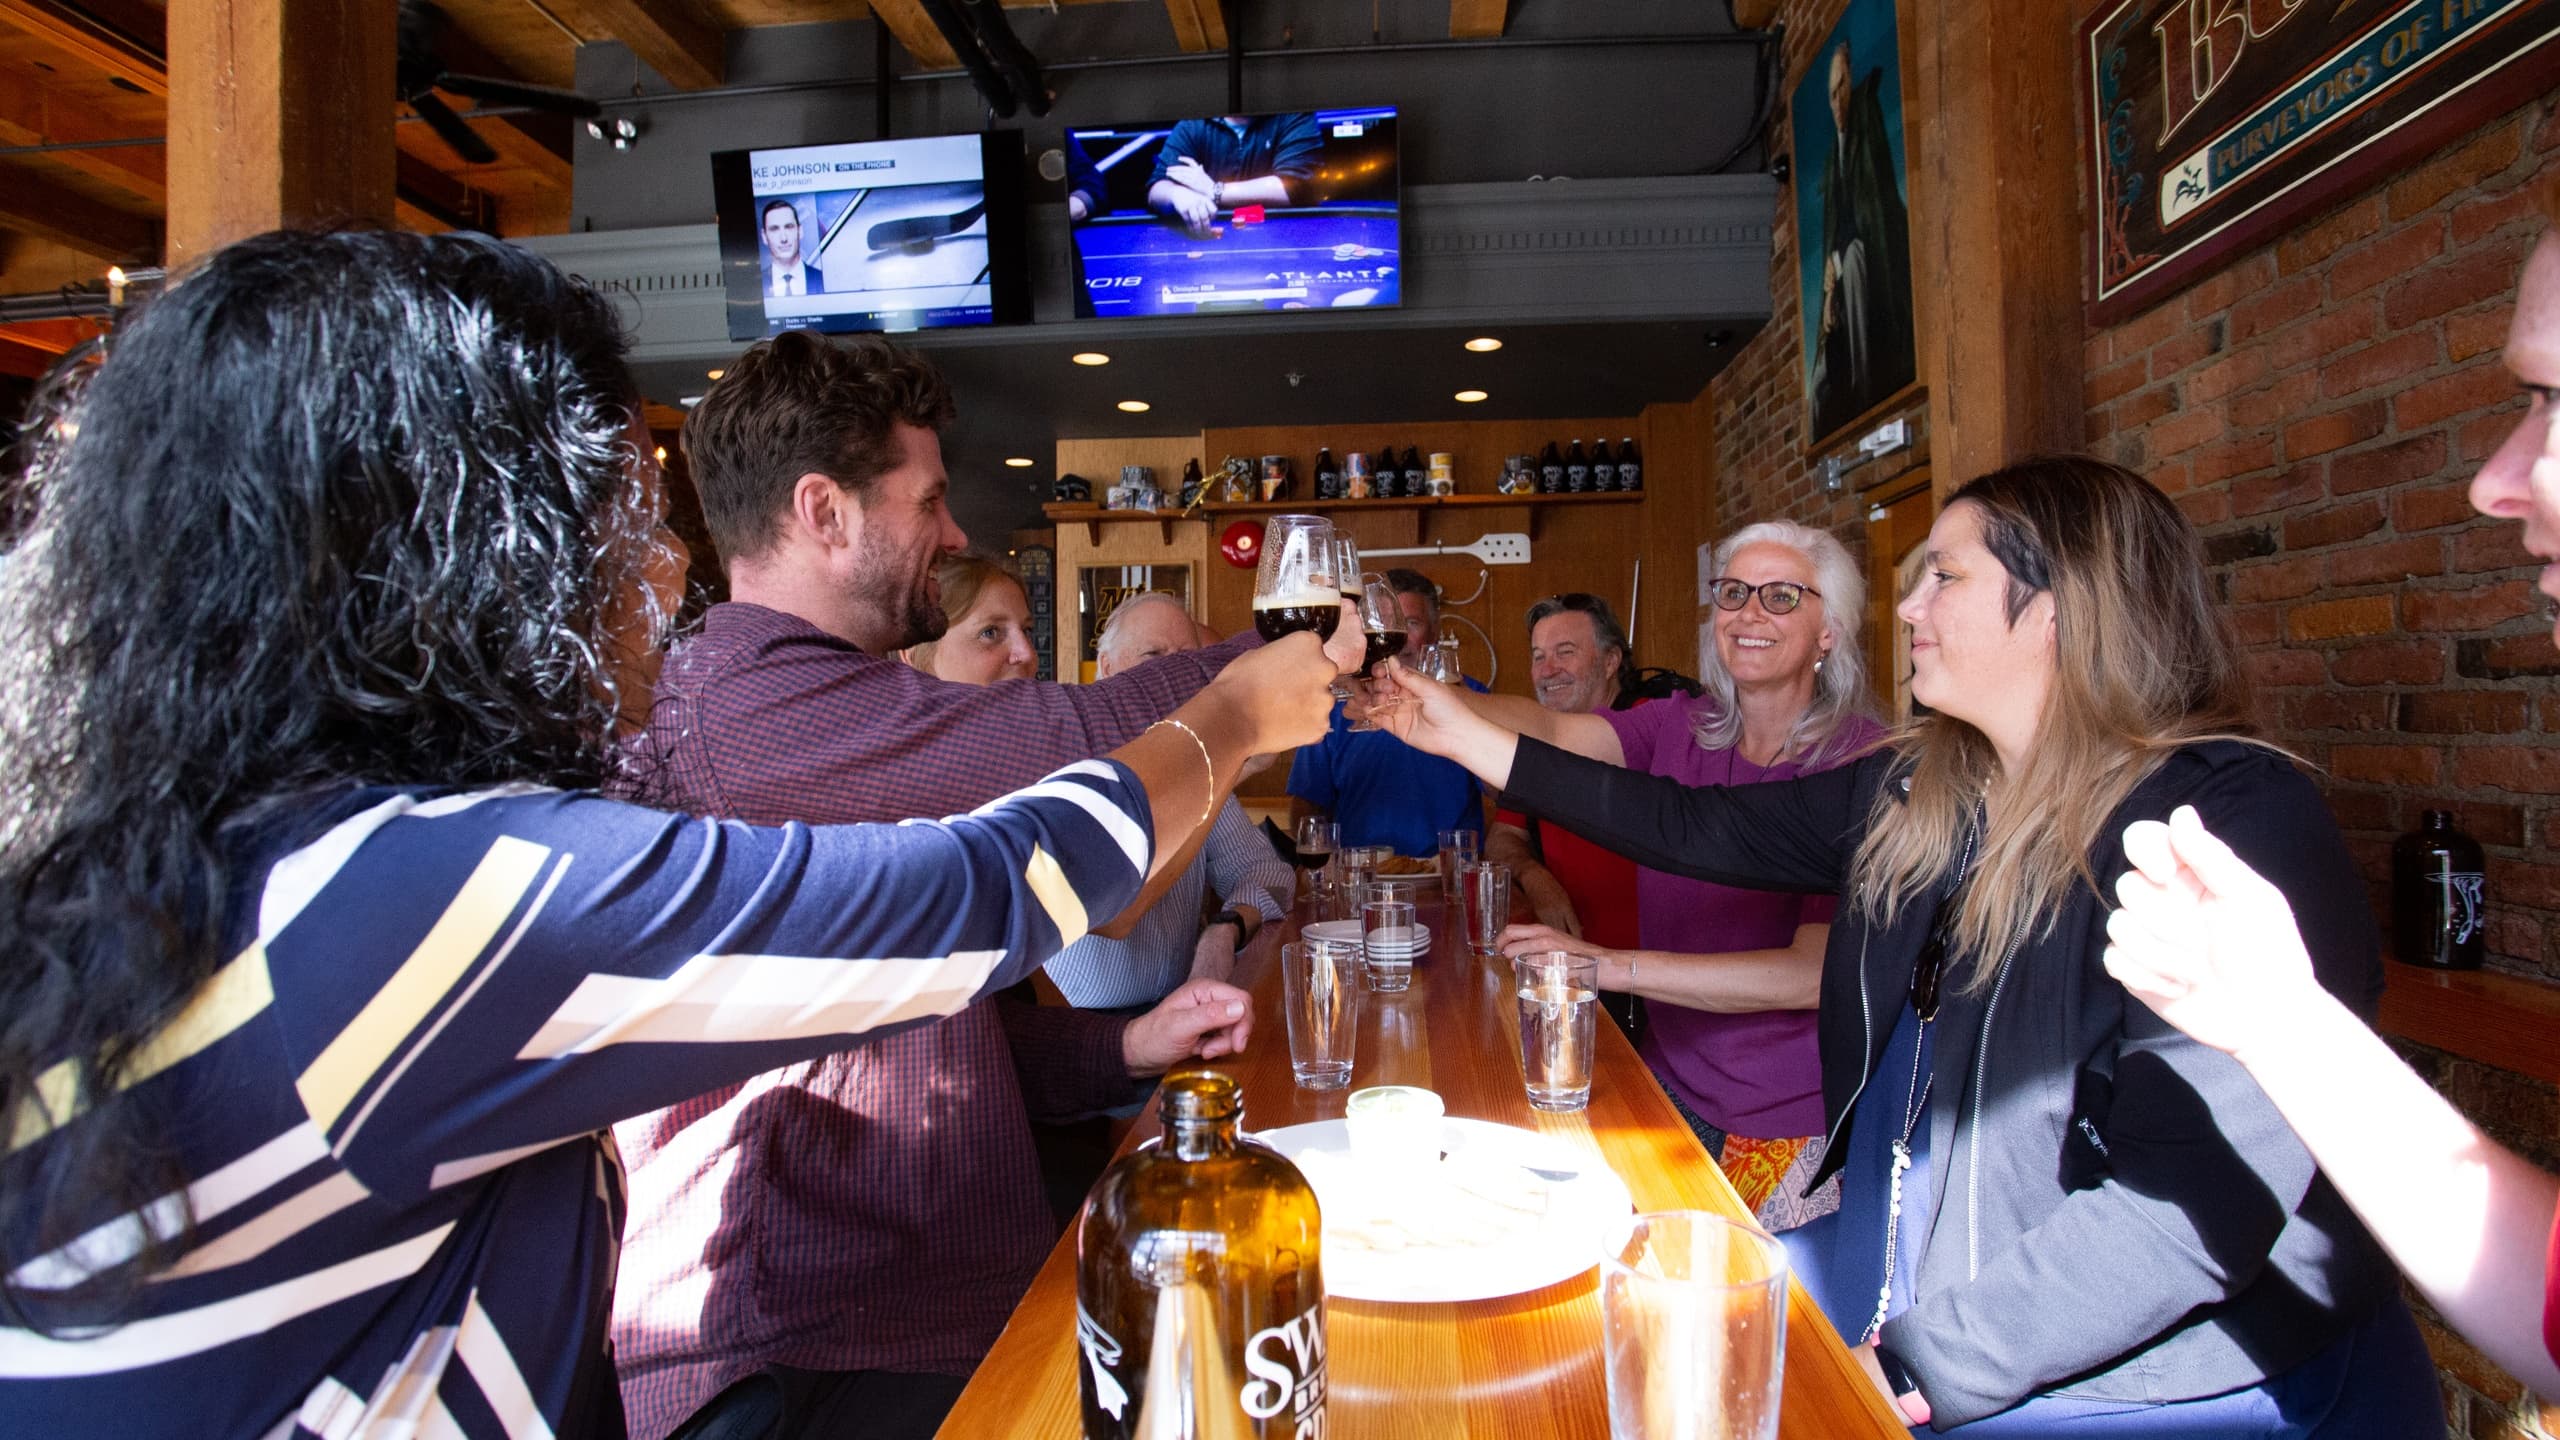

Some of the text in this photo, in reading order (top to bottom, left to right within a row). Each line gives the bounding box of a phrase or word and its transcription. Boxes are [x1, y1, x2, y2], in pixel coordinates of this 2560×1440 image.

[2216, 55, 2374, 177] PURVEYORS
[2381, 14, 2432, 68] OF
[772, 163, 831, 177] JOHNSON
[1085, 276, 1143, 288] 018
